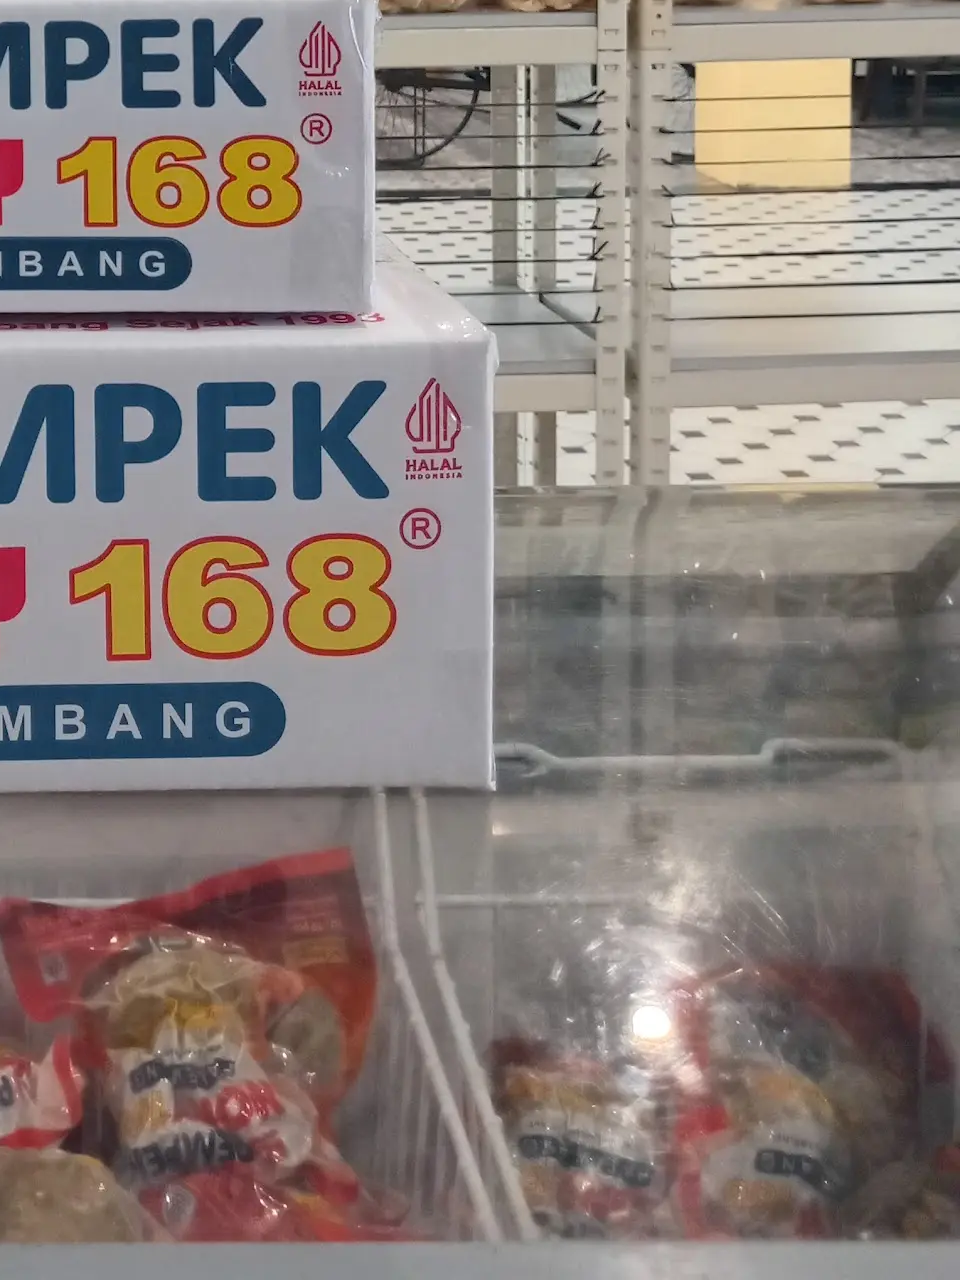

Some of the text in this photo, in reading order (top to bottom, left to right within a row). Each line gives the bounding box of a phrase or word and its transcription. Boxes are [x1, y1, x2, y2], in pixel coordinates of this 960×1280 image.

[299, 80, 342, 90] HALAL
[57, 135, 303, 228] 168
[126, 317, 260, 332] Sejak
[277, 312, 385, 326] 1993
[405, 458, 462, 472] HALAL
[405, 472, 463, 481] INDONESIA
[69, 532, 397, 663] 168
